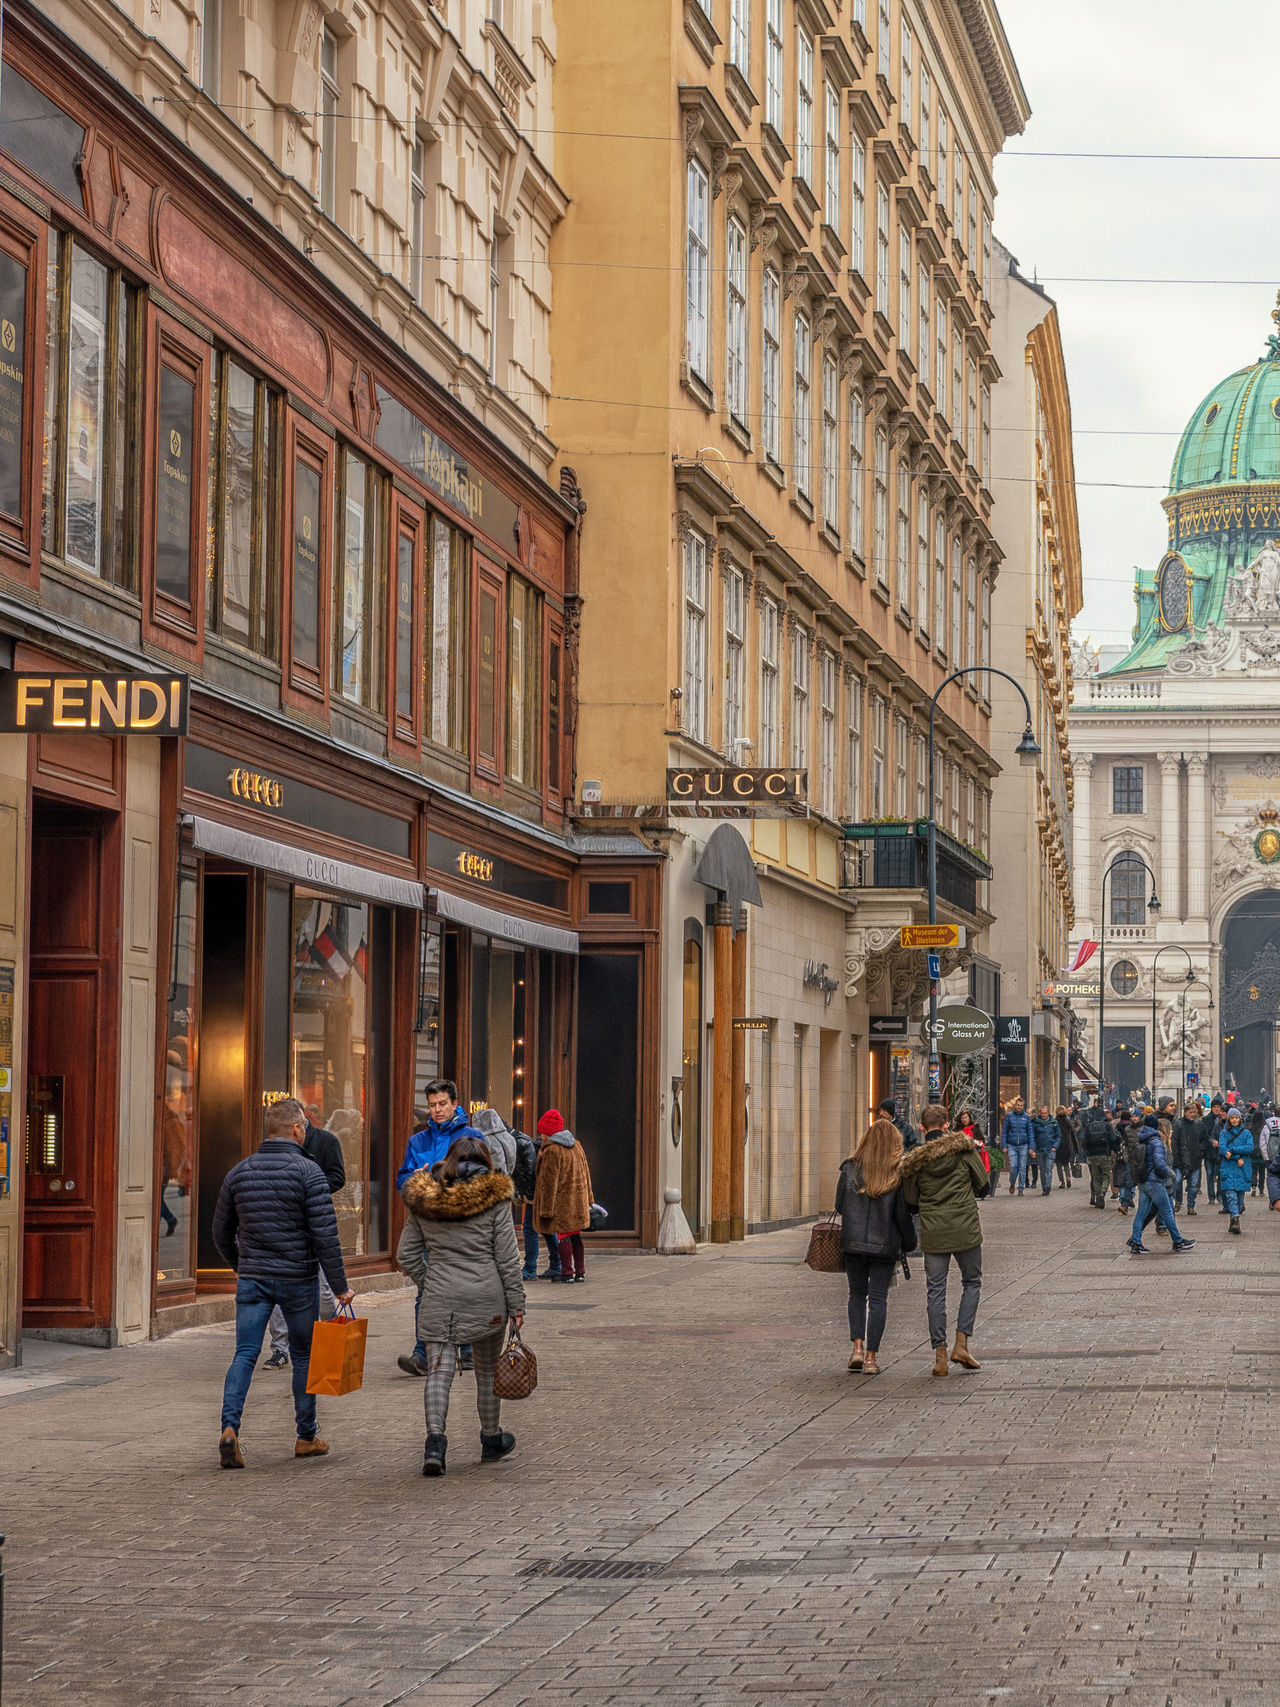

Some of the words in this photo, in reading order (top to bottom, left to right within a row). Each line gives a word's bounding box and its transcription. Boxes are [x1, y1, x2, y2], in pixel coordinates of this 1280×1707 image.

[0, 360, 23, 384] pskin
[163, 459, 187, 484] Topskin
[422, 430, 483, 520] Topkapi
[16, 678, 181, 728] FENDI
[672, 773, 801, 795] GUCCI
[306, 858, 339, 884] GUCCI
[503, 919, 524, 939] GUCCI
[916, 936, 945, 944] Illusionen
[1044, 982, 1101, 995] APOTHEKE
[948, 1021, 989, 1029] International
[952, 1030, 973, 1038] Glass
[973, 1030, 985, 1038] Art
